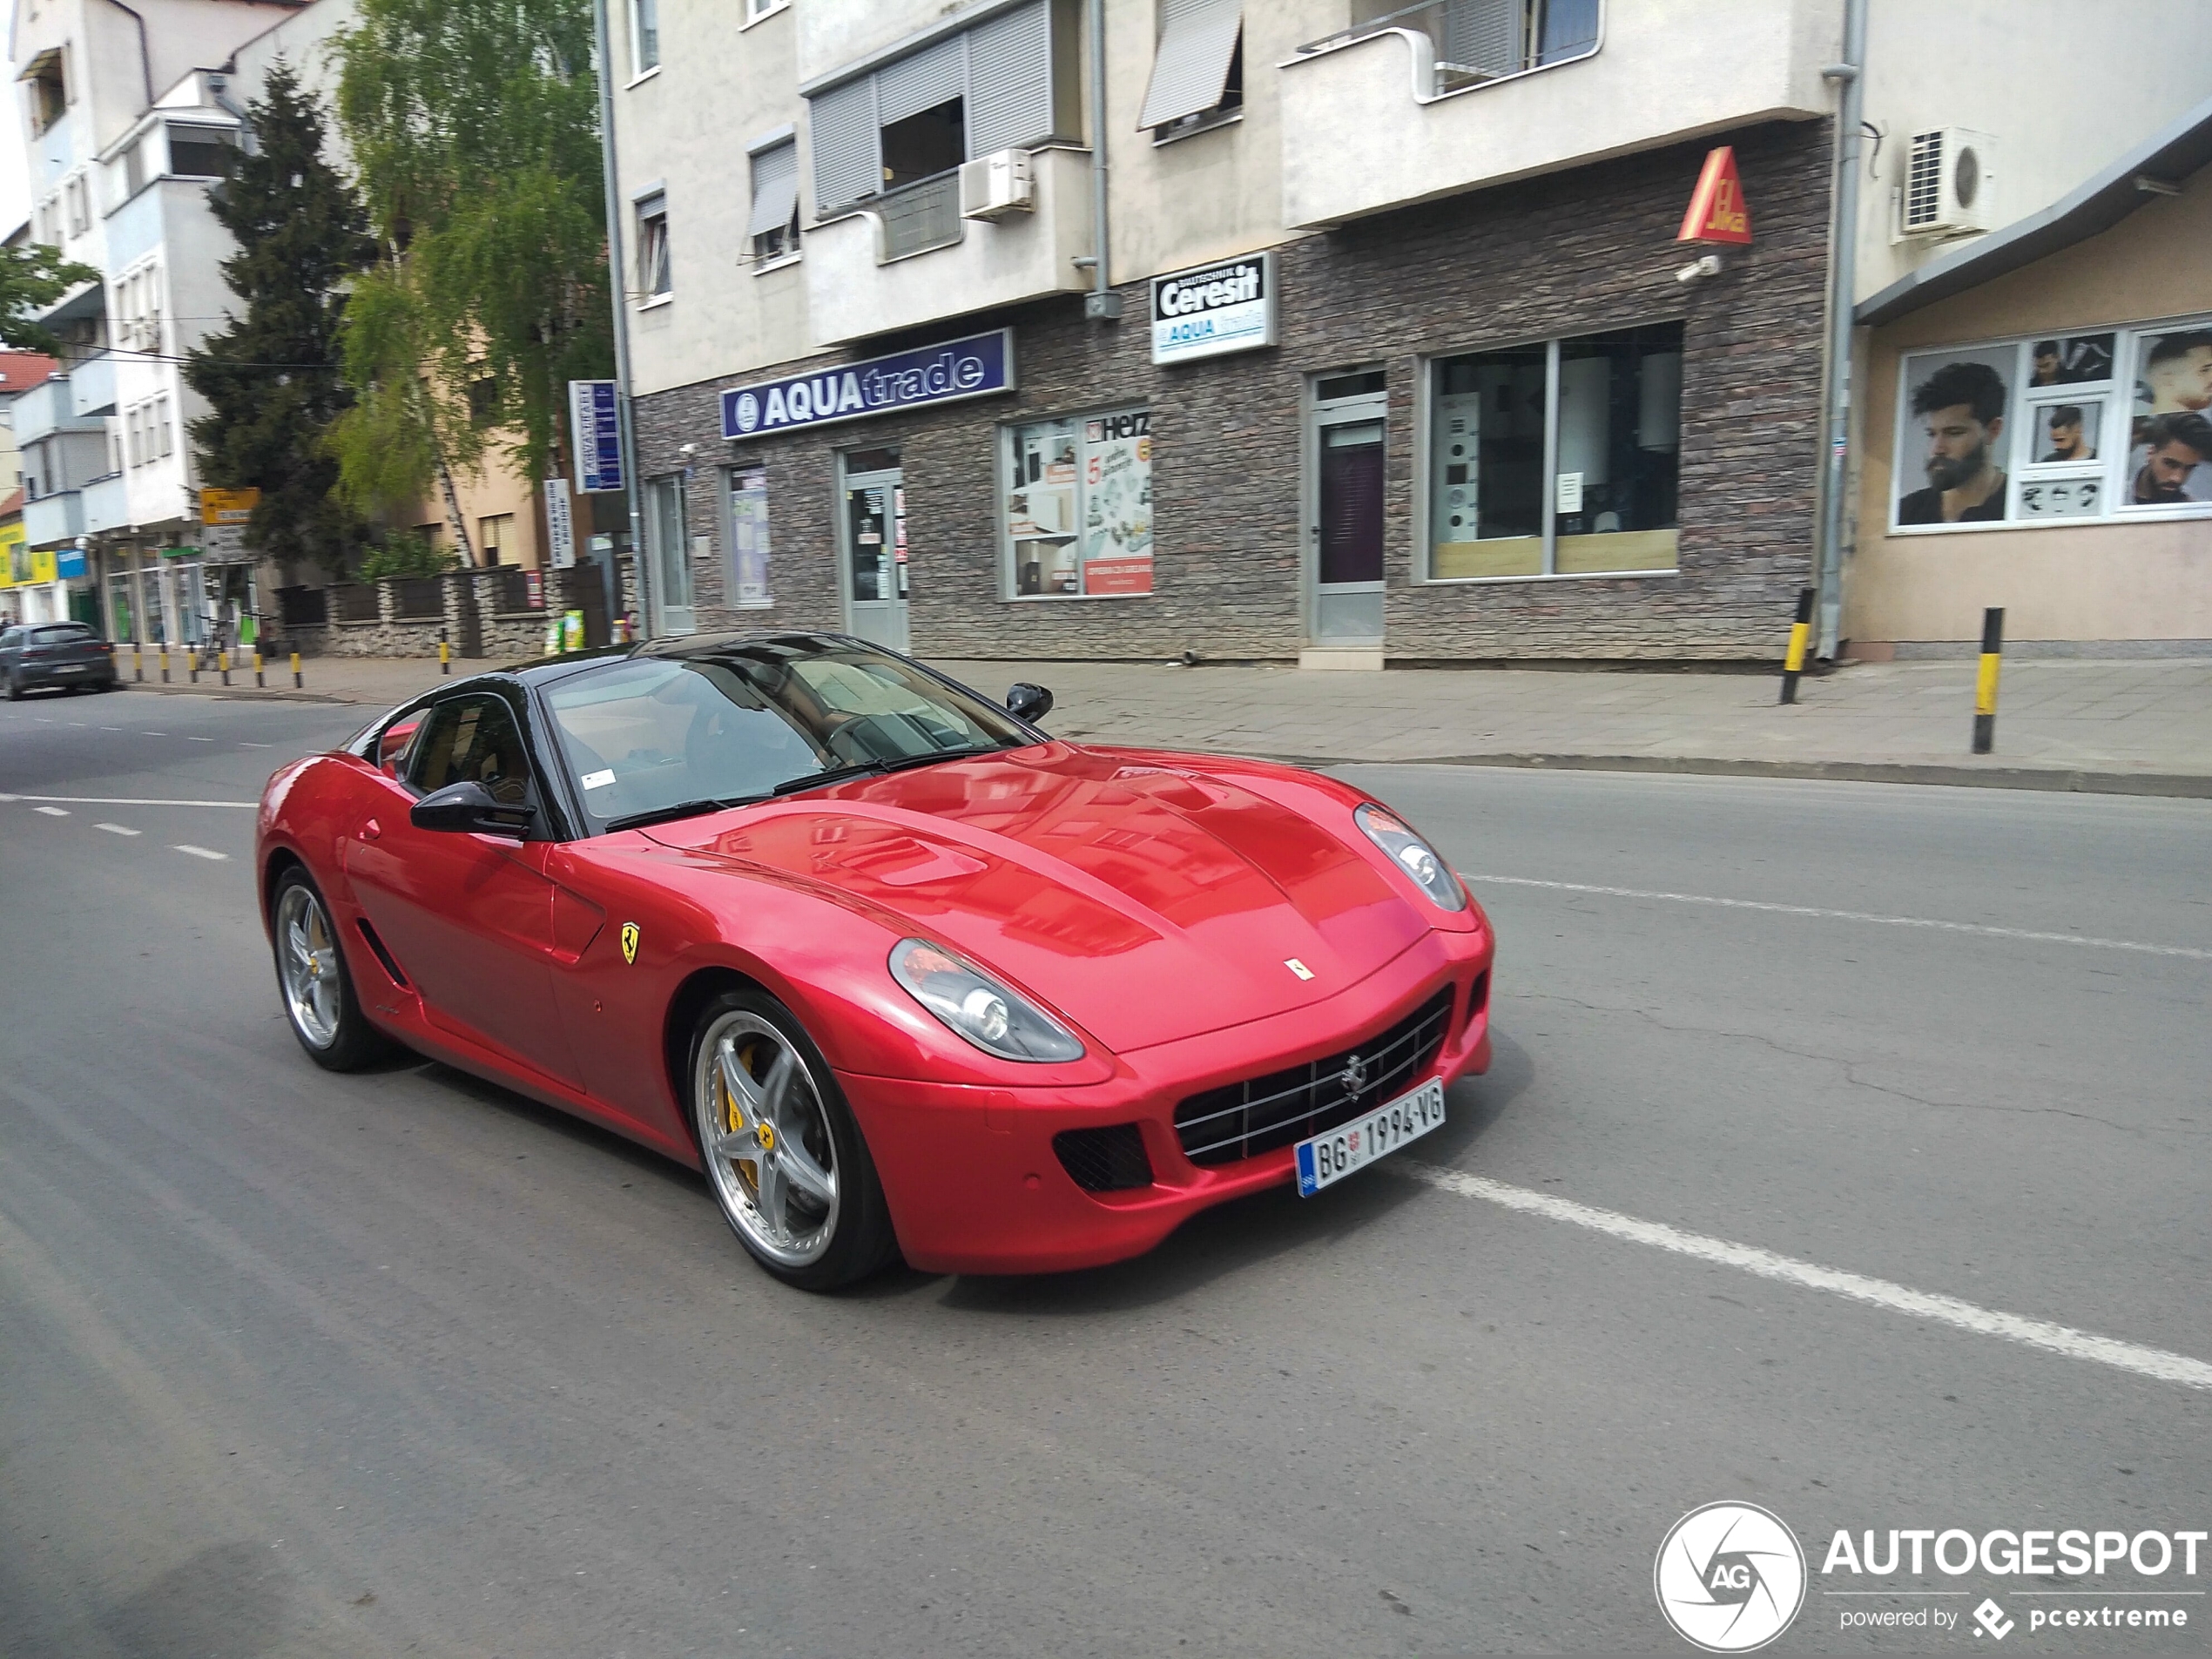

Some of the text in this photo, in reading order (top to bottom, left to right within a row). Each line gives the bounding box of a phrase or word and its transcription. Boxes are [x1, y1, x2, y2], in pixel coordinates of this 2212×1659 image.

[1159, 264, 1259, 316] Ceresit
[1169, 319, 1216, 342] AQUA
[1087, 455, 1102, 485] 5
[1318, 1086, 1442, 1179] BG 1994-VG
